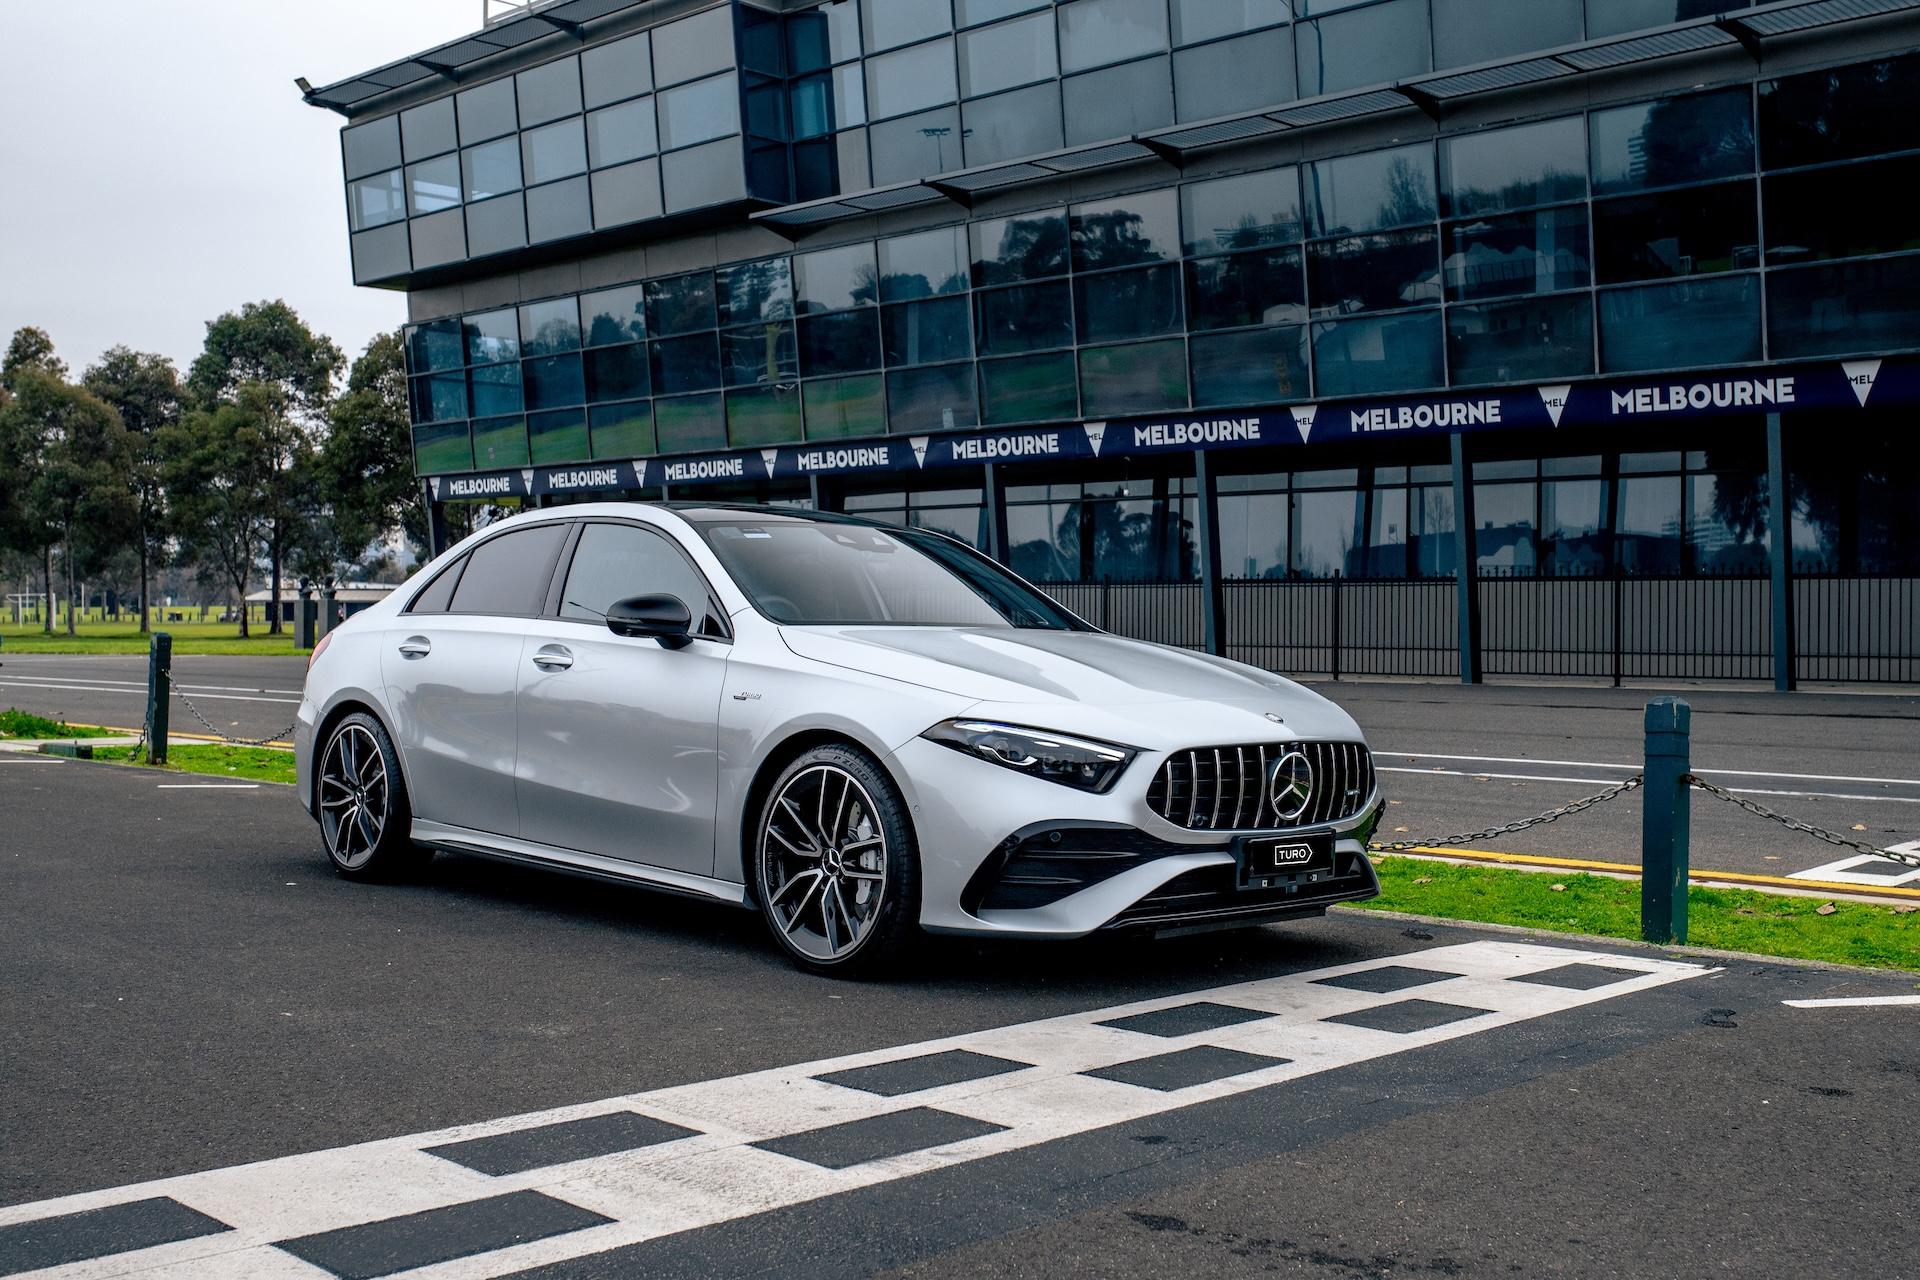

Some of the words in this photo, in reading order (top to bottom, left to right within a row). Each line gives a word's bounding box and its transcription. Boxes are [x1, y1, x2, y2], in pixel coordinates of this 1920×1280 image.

[1848, 374, 1875, 385] MEL
[1544, 398, 1566, 407] MEL
[1611, 377, 1796, 415] MELBOURNE
[1295, 417, 1313, 426] MEL
[1350, 400, 1501, 433] MELBOURNE
[1088, 432, 1104, 441] MEL
[1134, 418, 1261, 447] MELBOURNE
[951, 433, 1060, 460] MELBOURNE
[797, 446, 889, 471] MELBOURNE
[548, 468, 618, 489] MELBOURNE
[664, 458, 744, 481] MELBOURNE
[449, 476, 511, 496] MELBOURNE
[1279, 848, 1307, 860] TURO
